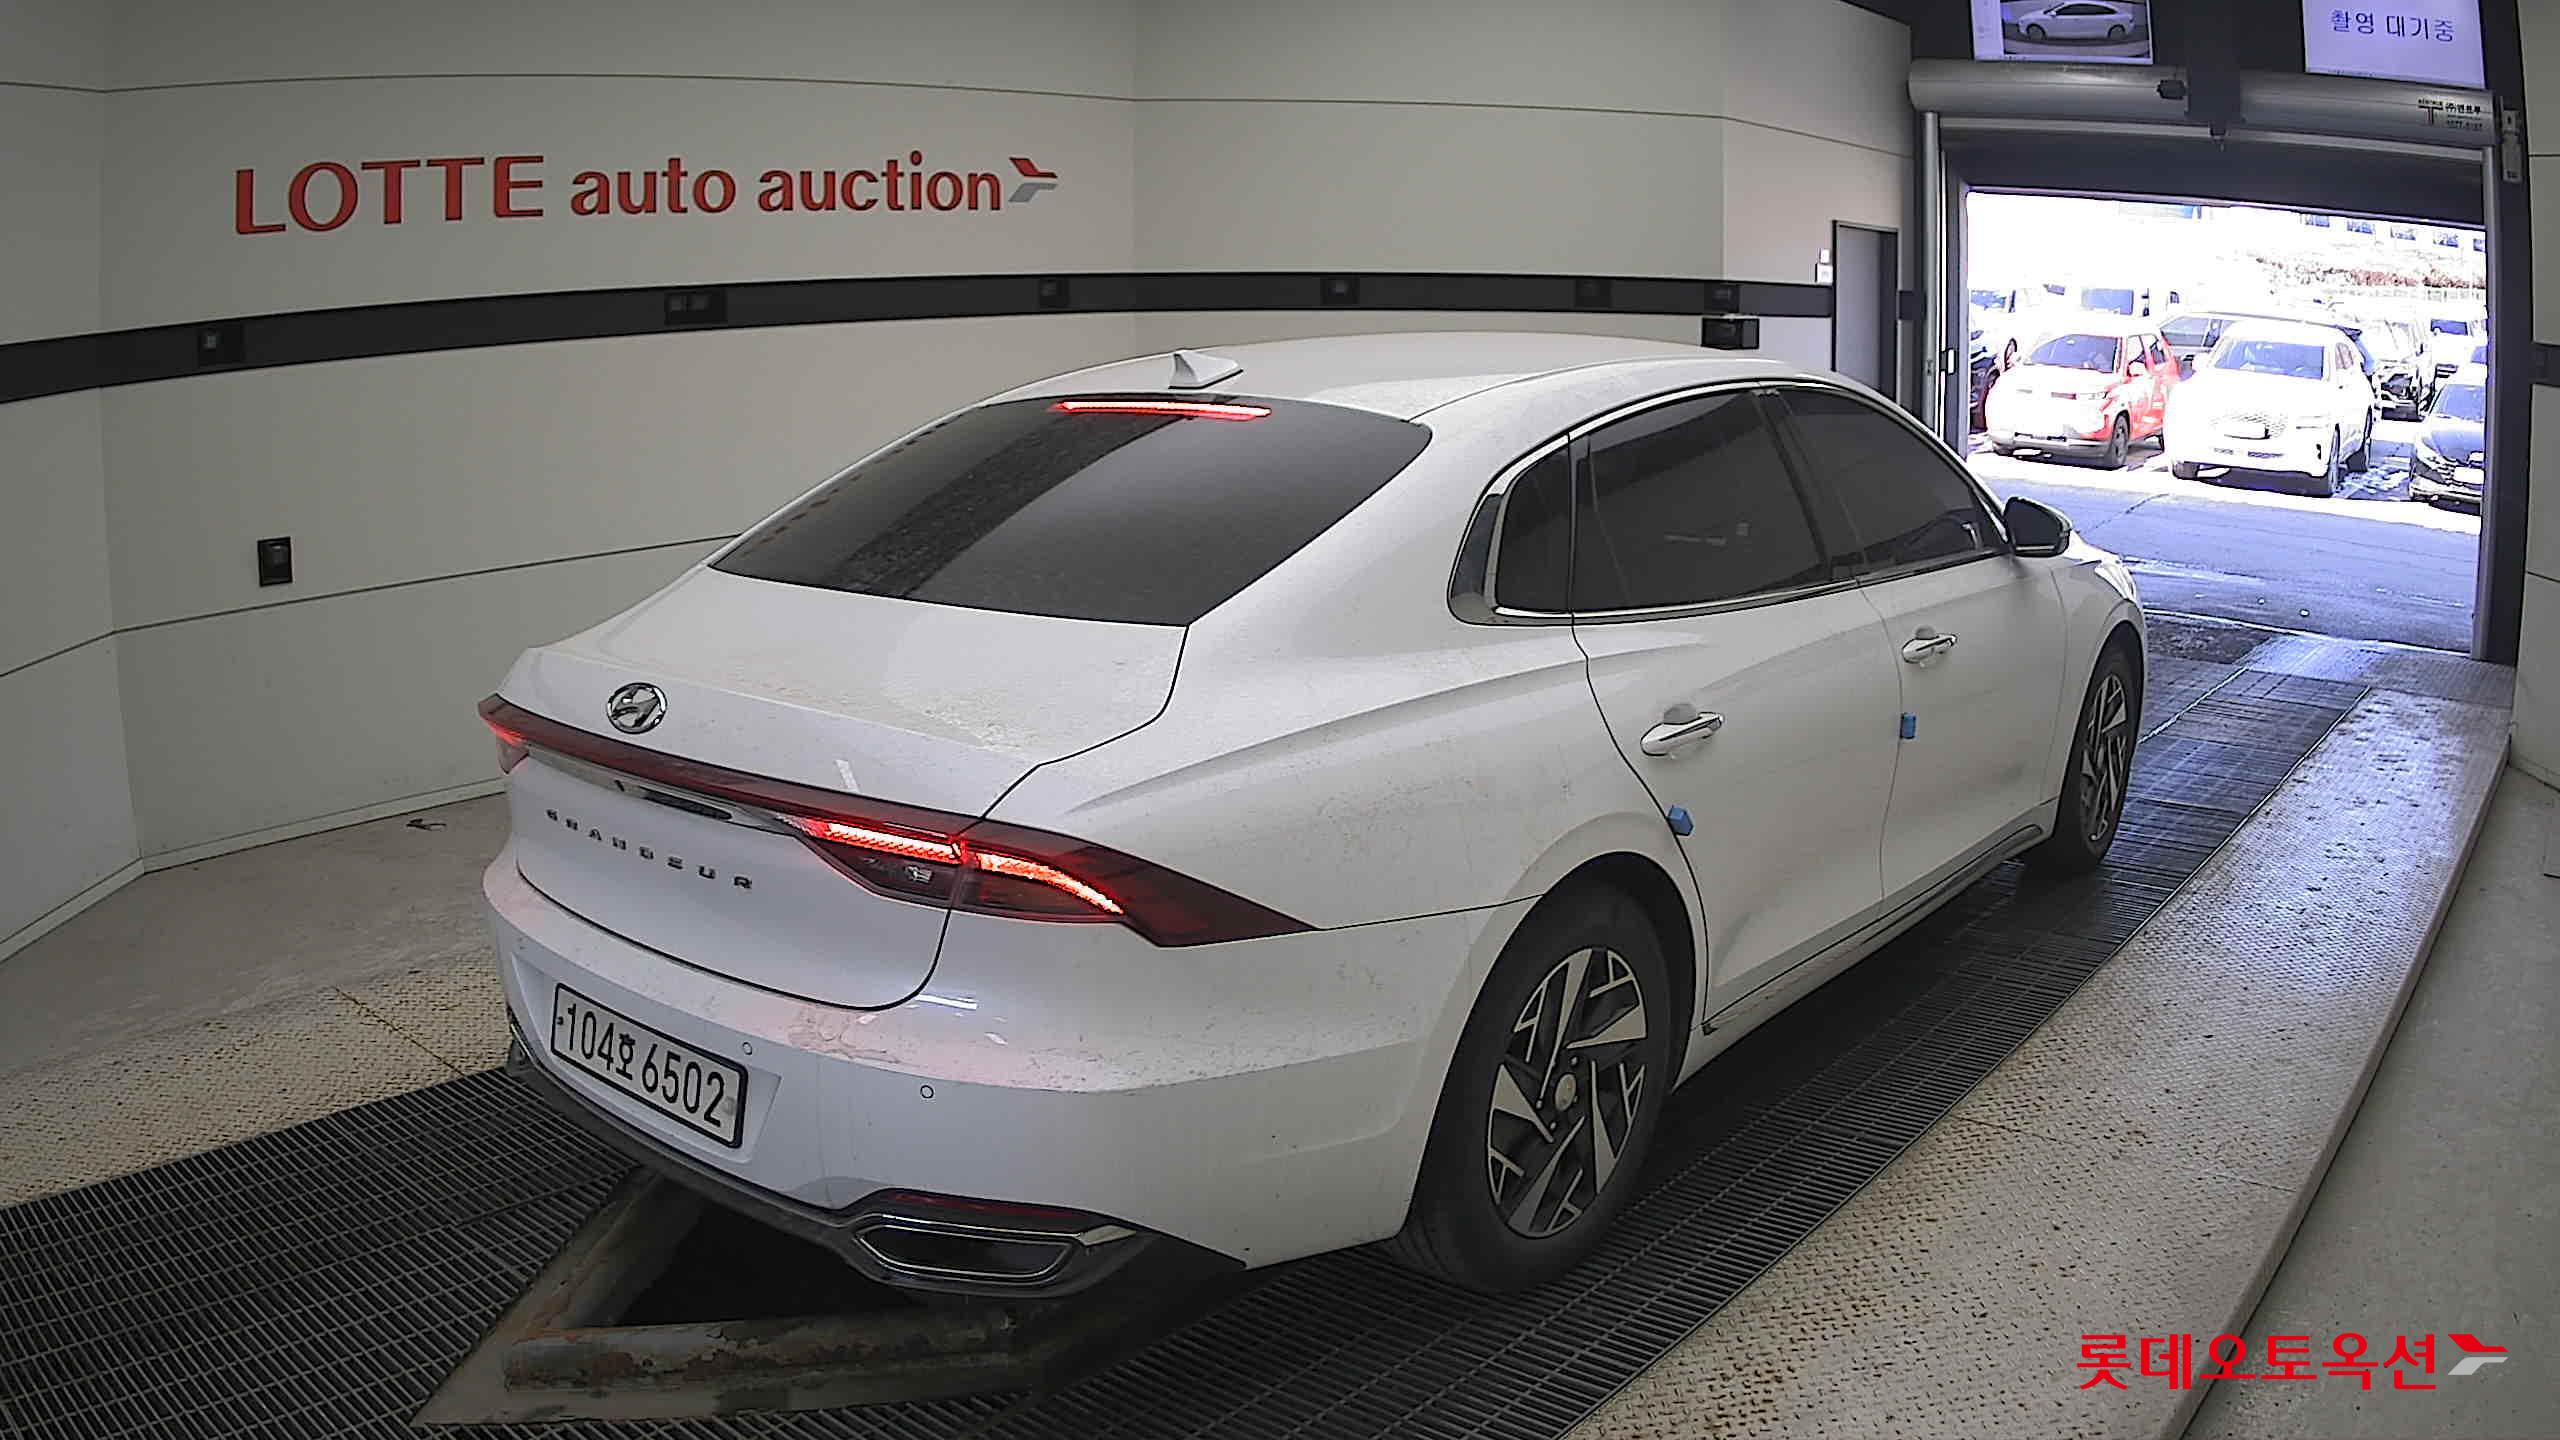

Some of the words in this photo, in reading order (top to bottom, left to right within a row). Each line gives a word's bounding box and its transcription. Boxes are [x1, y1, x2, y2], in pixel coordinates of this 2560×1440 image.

[2331, 10, 2375, 34] 촬영
[2386, 15, 2455, 42] 대기중
[235, 155, 544, 234] LOTTE
[570, 157, 737, 215] auto
[758, 150, 1001, 211] auction
